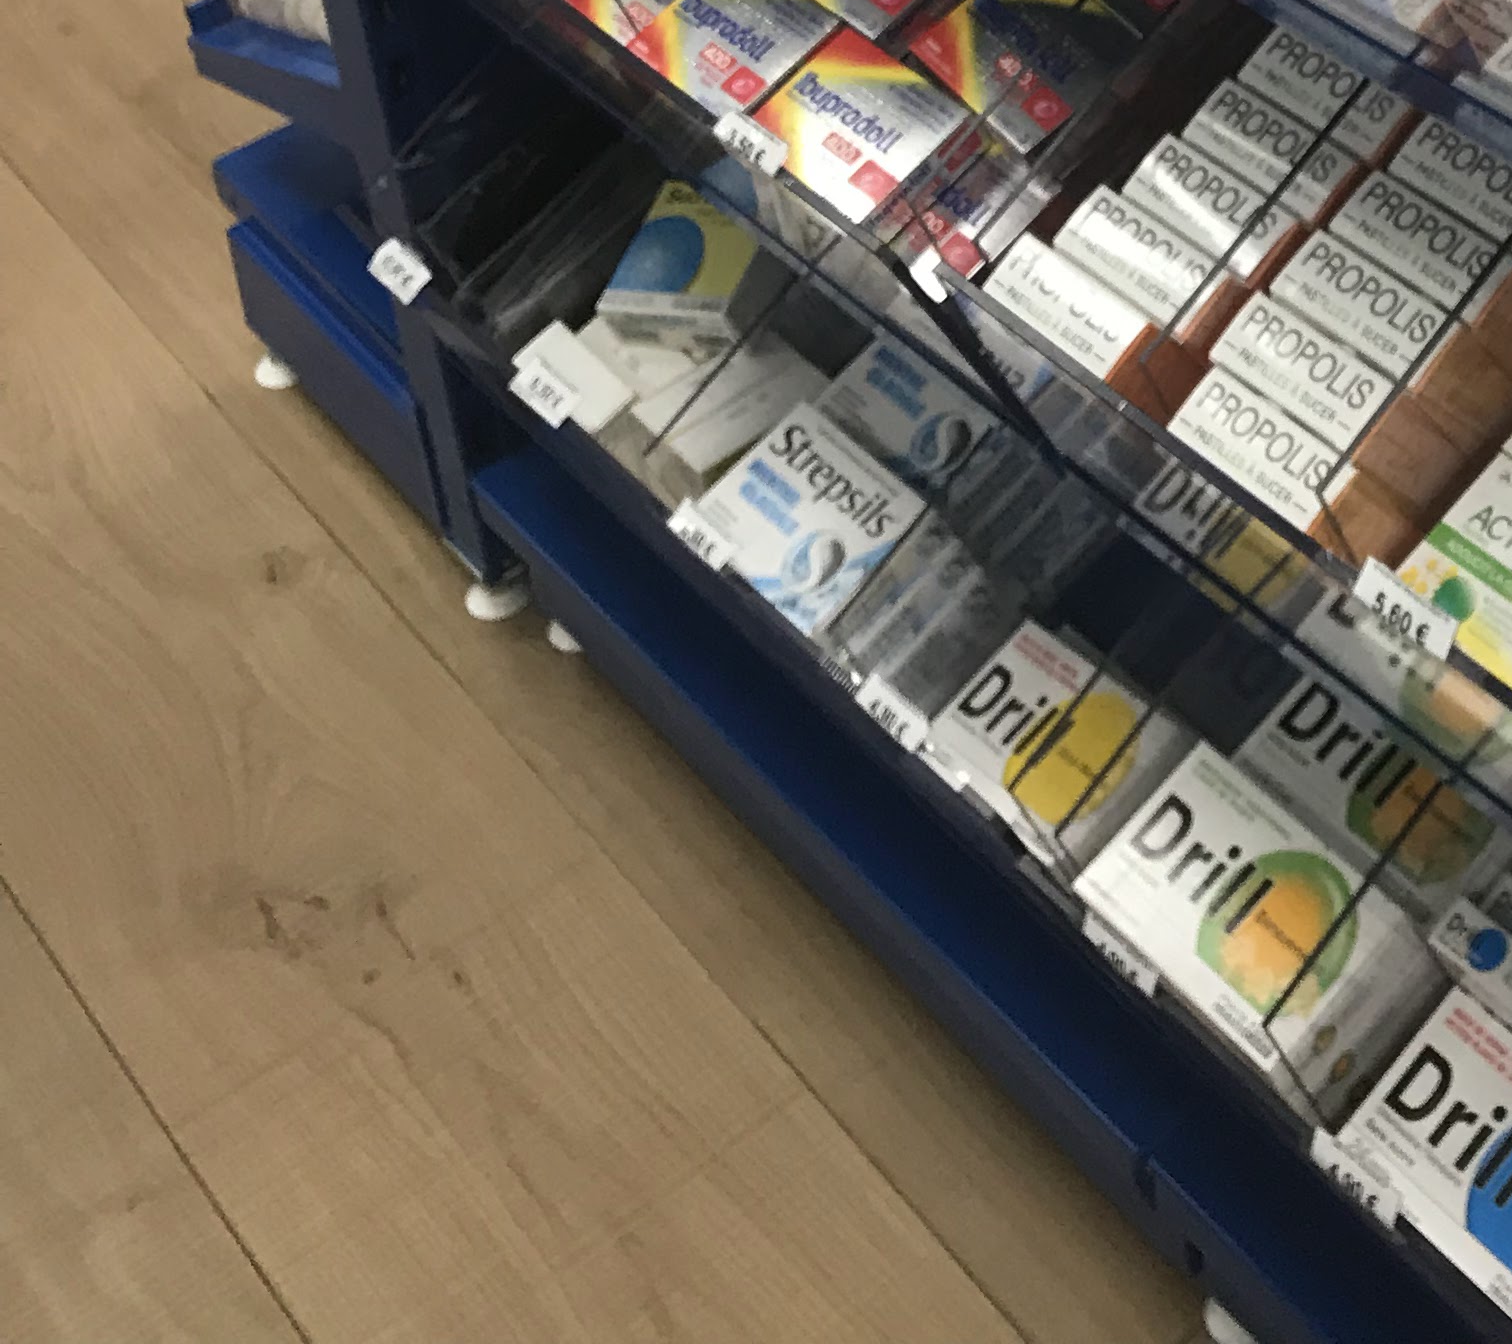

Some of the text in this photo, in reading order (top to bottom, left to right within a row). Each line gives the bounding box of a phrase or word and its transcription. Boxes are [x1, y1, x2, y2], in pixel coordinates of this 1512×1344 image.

[798, 74, 904, 153] Ibupradoll
[1300, 241, 1438, 345] PROPOLIS
[1240, 306, 1378, 410] PROPOLIS
[766, 423, 895, 538] Strepsils
[1202, 380, 1333, 494] PROPOLIS
[1370, 593, 1431, 643] 5,60 €
[956, 663, 1076, 754] Drill
[1278, 682, 1416, 807] Drill
[1126, 794, 1275, 934] Drill
